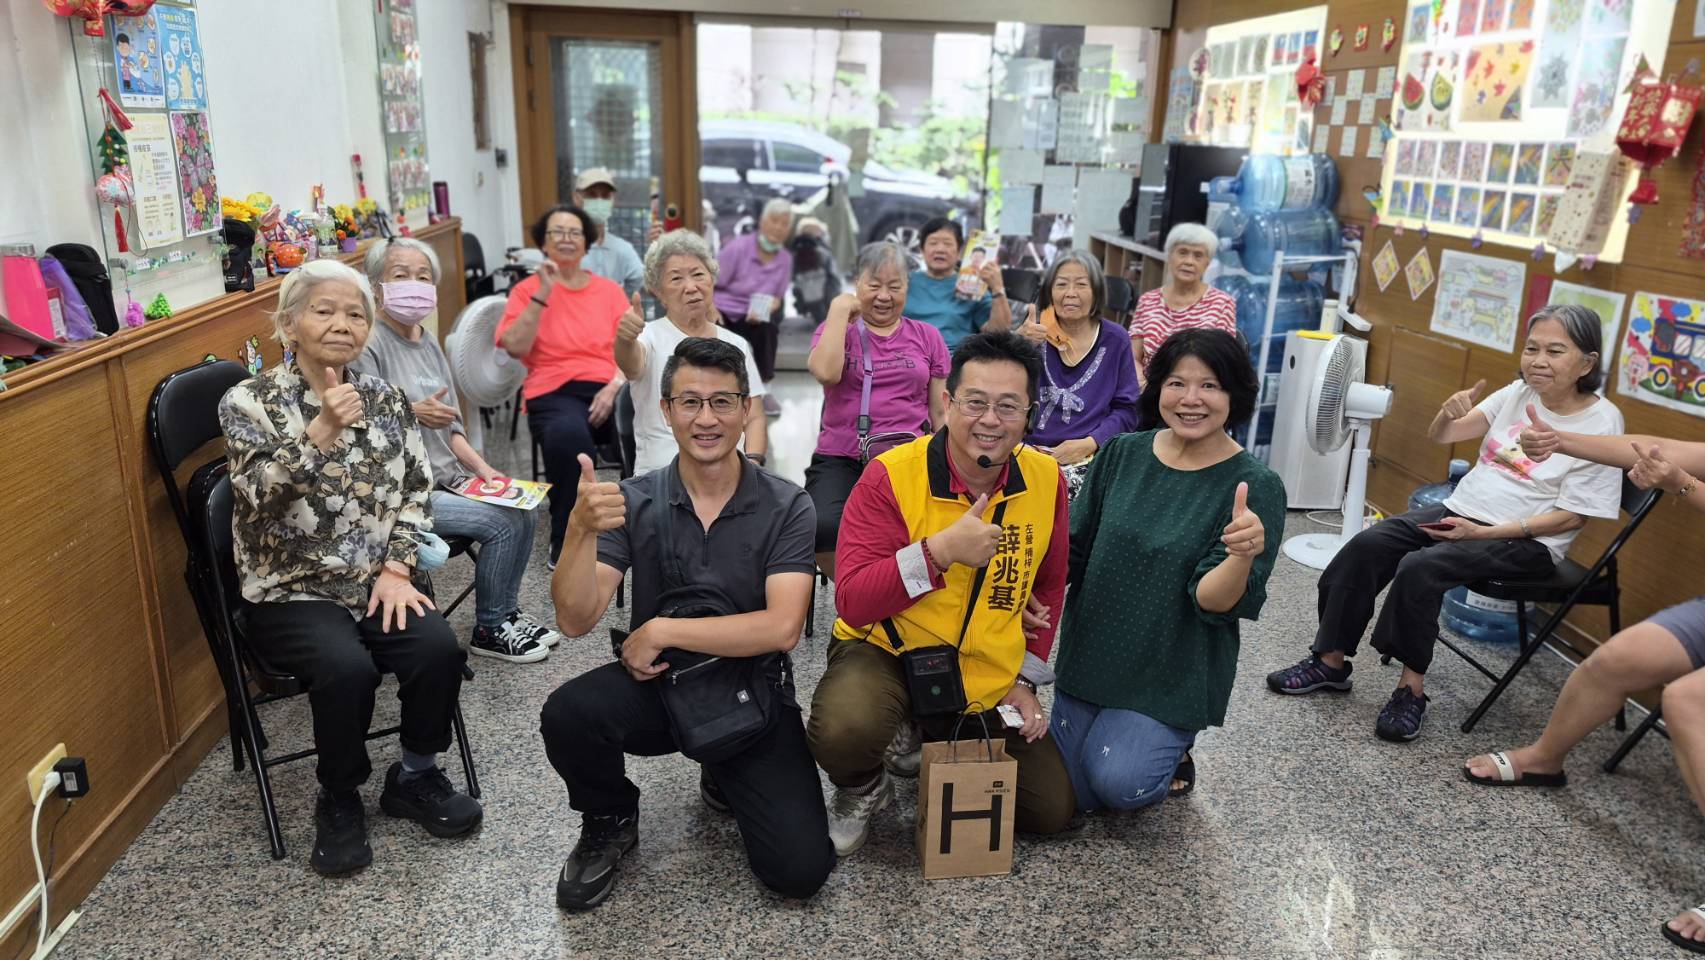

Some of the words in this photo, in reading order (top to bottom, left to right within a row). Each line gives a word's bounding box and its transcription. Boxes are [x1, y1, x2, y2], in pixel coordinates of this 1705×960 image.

[1025, 522, 1033, 545] 左營
[988, 523, 1020, 612] 薛兆基
[1024, 547, 1033, 569] 楠梓
[939, 782, 1003, 855] H
